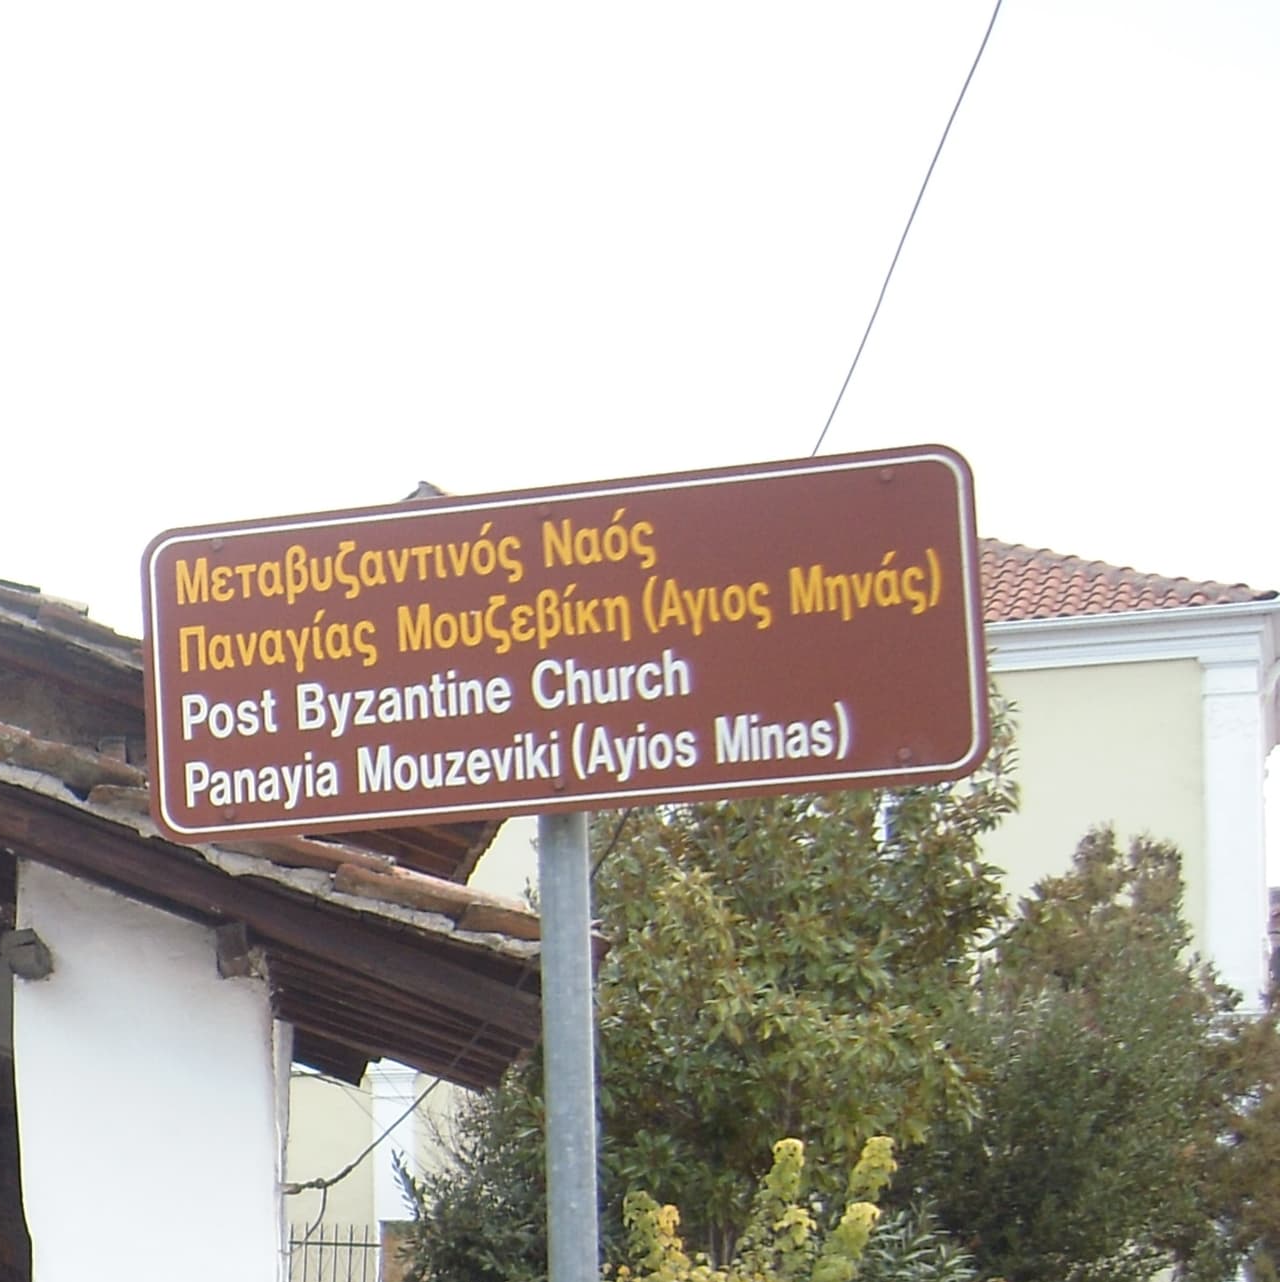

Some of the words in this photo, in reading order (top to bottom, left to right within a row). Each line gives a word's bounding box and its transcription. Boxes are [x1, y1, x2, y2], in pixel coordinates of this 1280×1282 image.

[175, 521, 523, 606] Μεταβυζαντινός
[541, 507, 656, 569] Ναός
[178, 610, 378, 673] Παναγίας
[396, 584, 632, 654] Μουζεβίκη
[642, 574, 772, 636] (Αγιος
[788, 548, 941, 621] Μηνάς)
[181, 689, 278, 741] Post
[295, 669, 512, 738] Byzantine
[530, 648, 691, 710] Church
[184, 752, 340, 810] Panayia
[356, 730, 562, 794] Mouzeviki
[571, 721, 698, 782] (Ayios
[714, 700, 850, 765] Minas)
